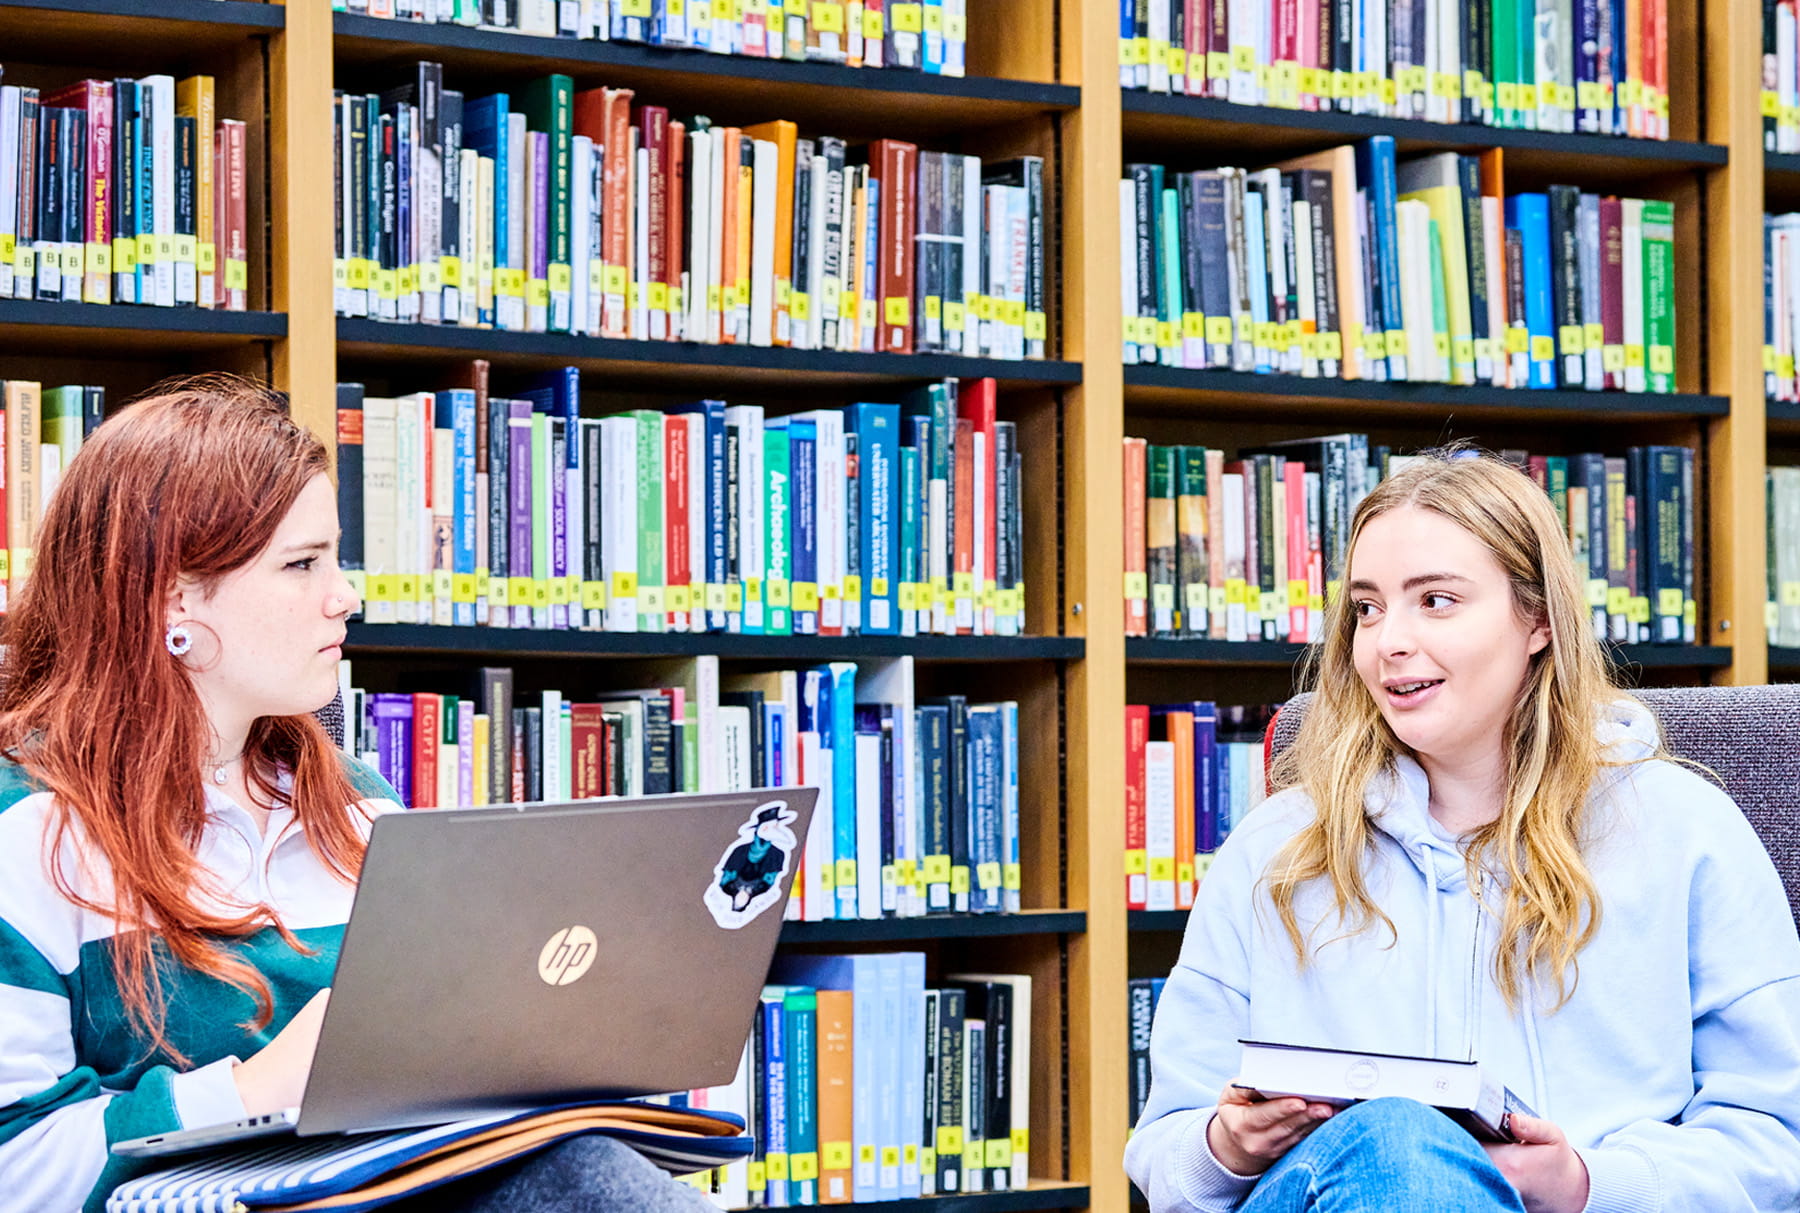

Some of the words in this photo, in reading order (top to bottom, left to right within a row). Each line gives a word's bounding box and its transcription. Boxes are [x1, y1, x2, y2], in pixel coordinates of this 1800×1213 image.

[95, 178, 106, 198] The
[6, 242, 13, 253] B
[47, 252, 54, 263] B
[97, 254, 105, 265] B
[24, 257, 31, 267] B
[70, 257, 78, 267] B
[21, 392, 32, 436] ALFRED
[464, 407, 475, 456] Between
[713, 433, 723, 457] THE
[464, 457, 475, 492] Bands
[464, 493, 475, 515] and
[464, 516, 475, 551] States
[554, 508, 565, 536] SOCIAL
[554, 537, 565, 570] AGENCY
[713, 533, 723, 557] OLD
[422, 703, 435, 758] EGYPT
[462, 709, 473, 769] EGYPT
[544, 926, 594, 985] hp
[942, 1056, 951, 1102] ROMAN
